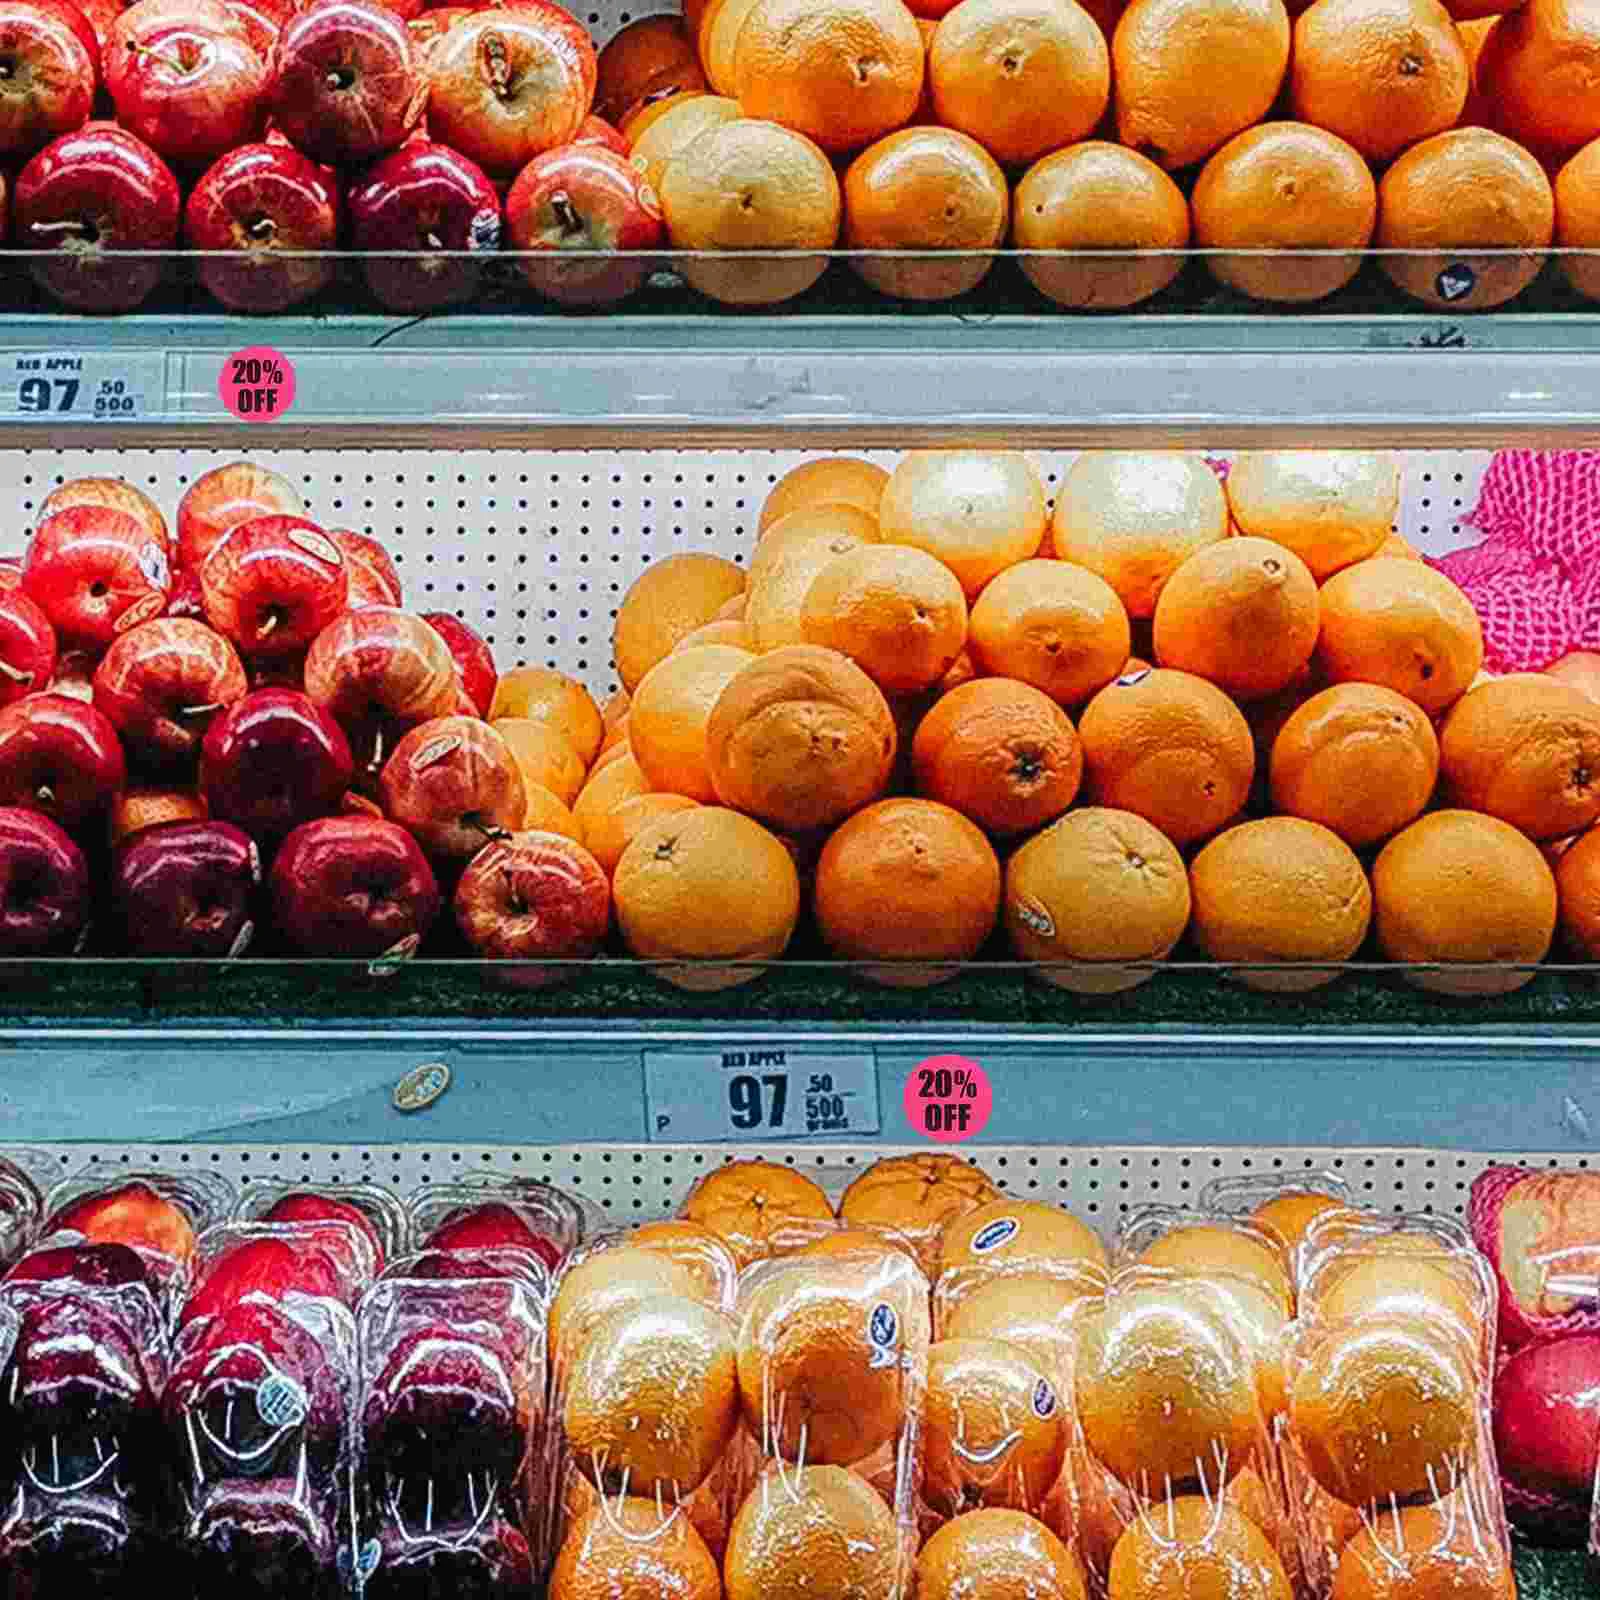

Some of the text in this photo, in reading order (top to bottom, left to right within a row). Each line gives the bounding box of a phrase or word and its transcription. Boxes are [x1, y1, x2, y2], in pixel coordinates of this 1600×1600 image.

[231, 359, 284, 384] 20%
[18, 378, 80, 411] 97
[237, 388, 279, 413] OFF
[918, 1069, 978, 1098] 20%
[729, 1074, 788, 1129] 97
[806, 1095, 844, 1119] 500
[925, 1103, 972, 1132] OFF
